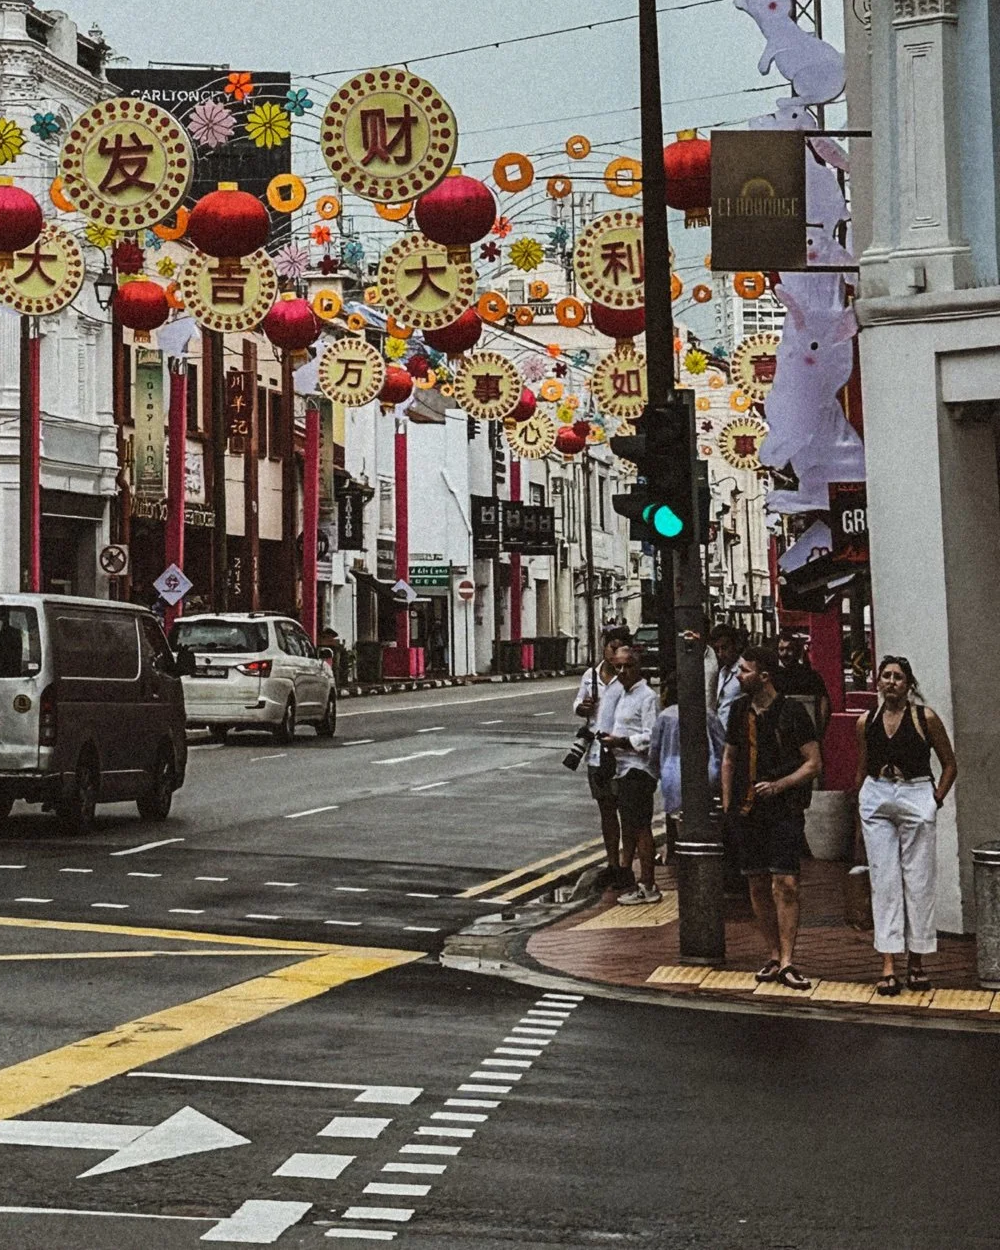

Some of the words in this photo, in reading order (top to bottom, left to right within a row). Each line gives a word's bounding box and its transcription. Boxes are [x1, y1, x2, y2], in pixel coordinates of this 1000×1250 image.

[130, 89, 199, 102] CARLTON
[359, 103, 418, 167] 财
[97, 132, 156, 194] 发
[14, 242, 56, 287] 大
[404, 255, 449, 301] 大
[600, 240, 643, 286] 利
[208, 264, 251, 306] 吉
[336, 359, 363, 388] 万
[472, 372, 503, 402] 事
[610, 369, 643, 398] 如
